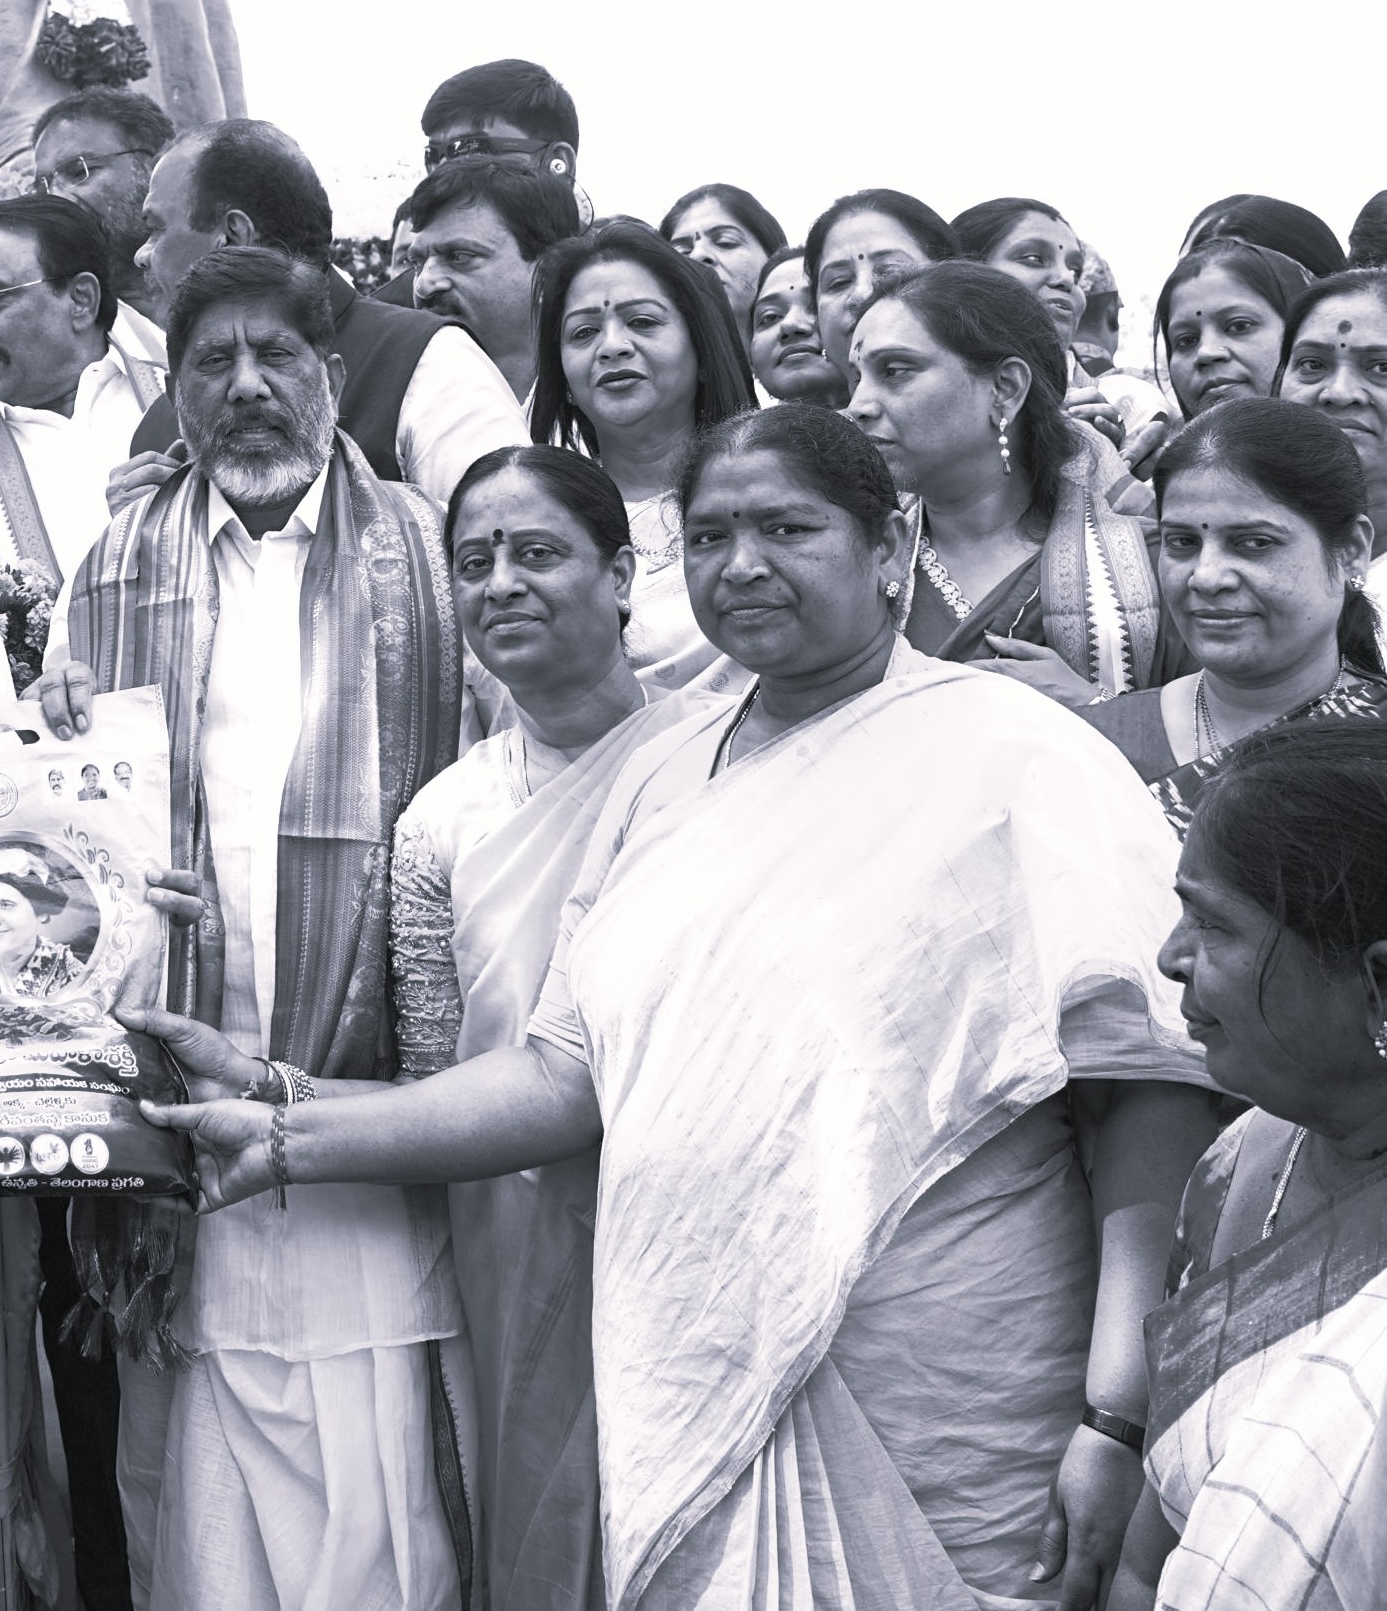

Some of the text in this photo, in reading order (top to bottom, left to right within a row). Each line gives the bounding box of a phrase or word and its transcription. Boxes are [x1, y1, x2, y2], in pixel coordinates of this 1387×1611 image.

[35, 1077, 88, 1089] సహాయక
[64, 1112, 109, 1125] కానుక
[50, 1177, 108, 1188] తెలంగాణ
[111, 1177, 145, 1189] ప్రగతి
